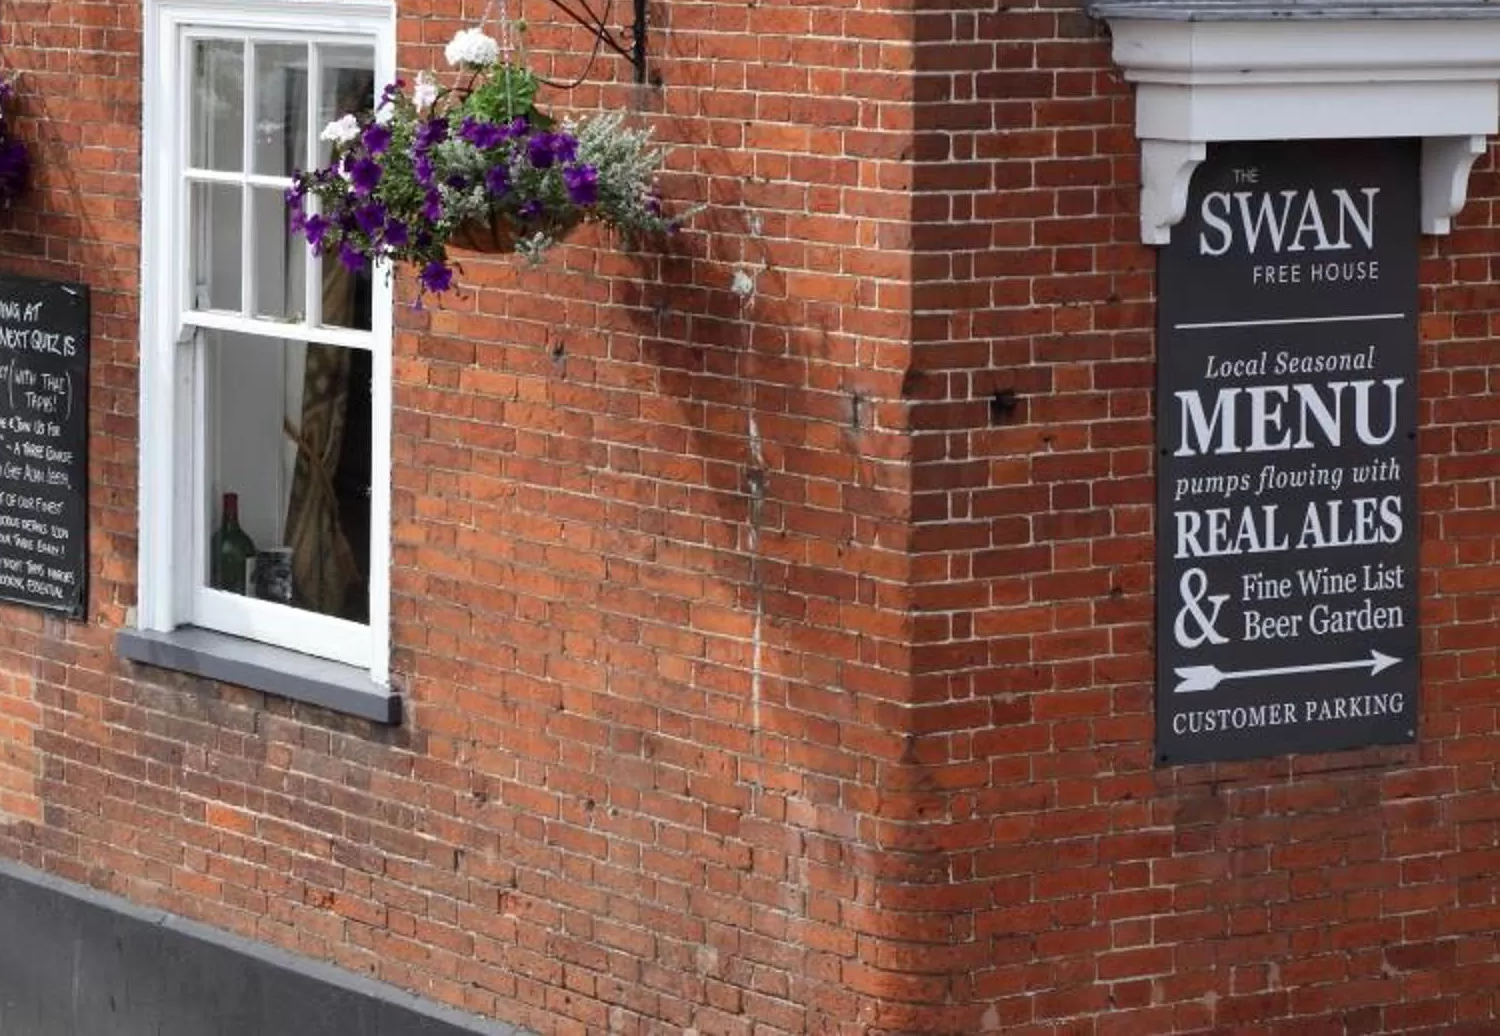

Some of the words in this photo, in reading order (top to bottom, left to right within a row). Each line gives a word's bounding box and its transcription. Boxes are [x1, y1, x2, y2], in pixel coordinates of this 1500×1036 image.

[1232, 168, 1259, 184] THE
[1200, 187, 1381, 256] SWAN
[1253, 264, 1301, 285] FREE
[1311, 261, 1380, 283] HOUSE
[23, 301, 43, 322] AT
[31, 330, 62, 355] QUIZ
[63, 335, 76, 357] IS
[1205, 351, 1267, 379] Local
[1275, 345, 1376, 376] Seasonal
[1174, 378, 1405, 457] MENU
[1174, 472, 1251, 501] pumps
[1255, 463, 1343, 496] flowing
[1352, 457, 1401, 484] with
[1174, 504, 1289, 559] REAL
[1296, 495, 1404, 549] ALES
[1242, 572, 1292, 601] Fine
[1297, 567, 1357, 597] Wine
[1362, 563, 1405, 592] List
[1173, 567, 1231, 649] &
[1243, 609, 1303, 641] Beer
[1309, 599, 1404, 636] Garden
[1173, 702, 1298, 736] CUSTOMER
[1305, 692, 1405, 723] PARKING
